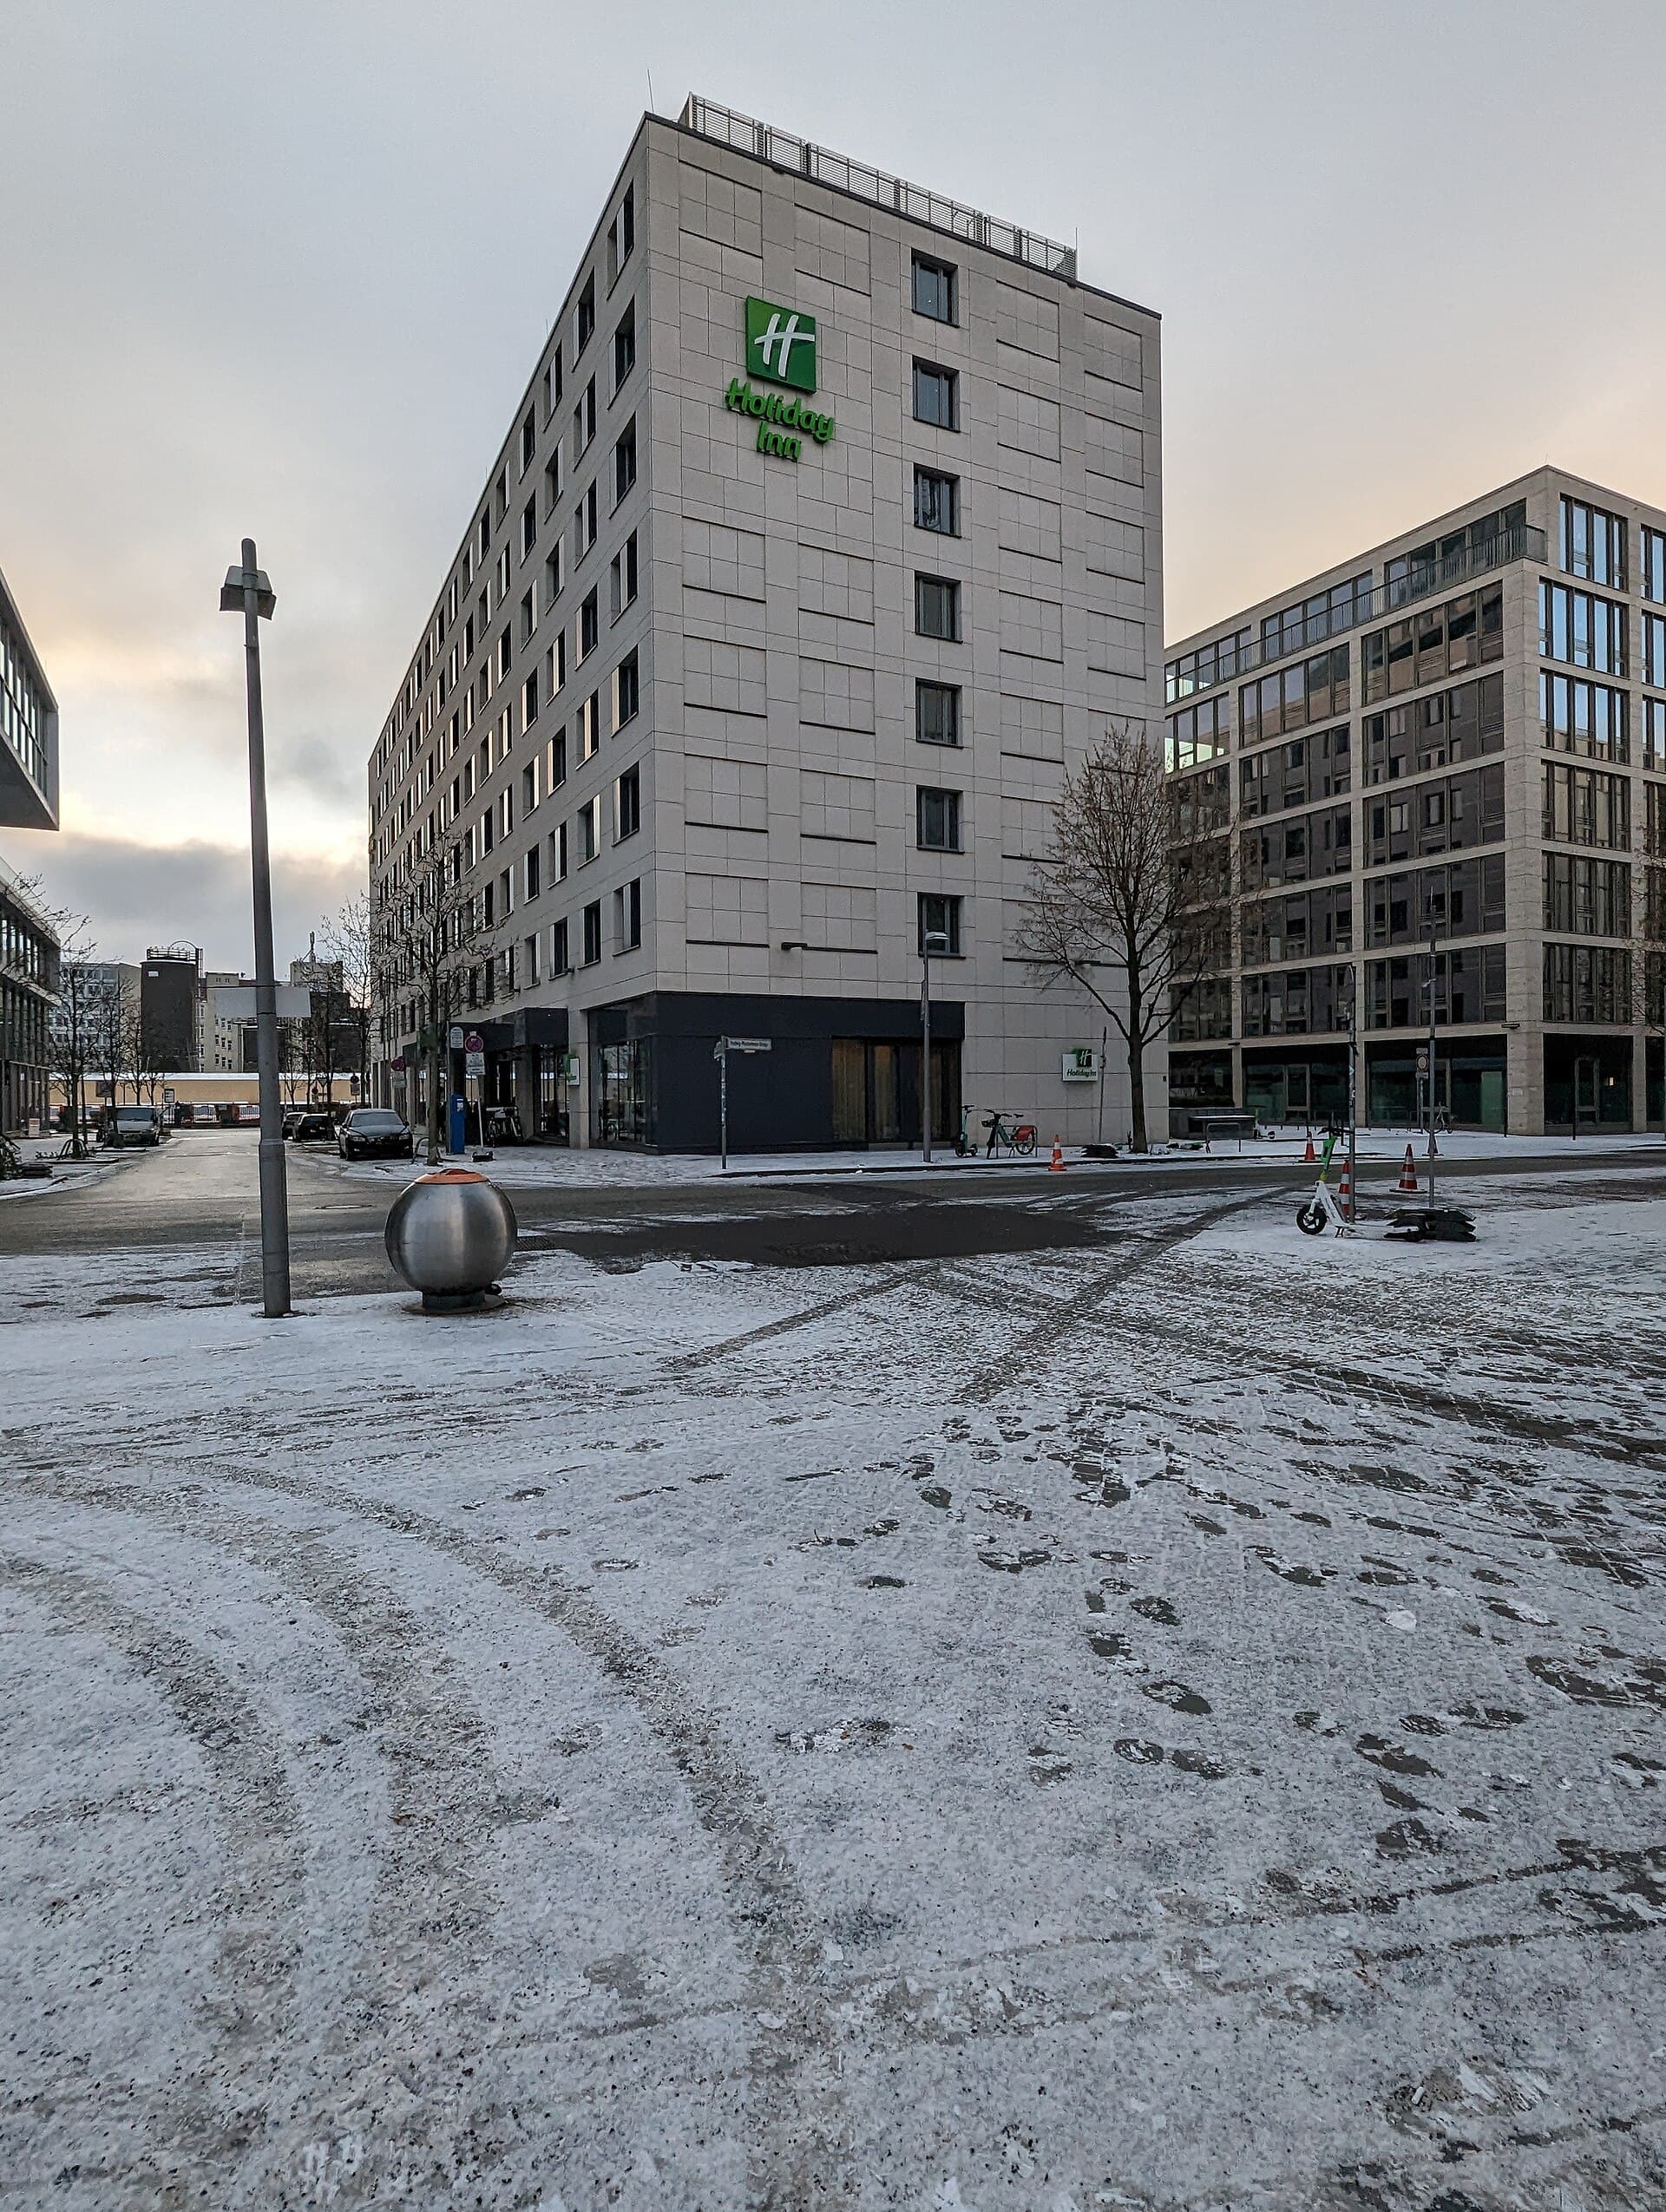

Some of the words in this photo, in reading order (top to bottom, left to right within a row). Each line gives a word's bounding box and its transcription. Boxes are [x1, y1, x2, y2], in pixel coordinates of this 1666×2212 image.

[725, 377, 834, 443] Holiday
[757, 420, 802, 461] Inn
[1066, 1068, 1090, 1077] Holiday
